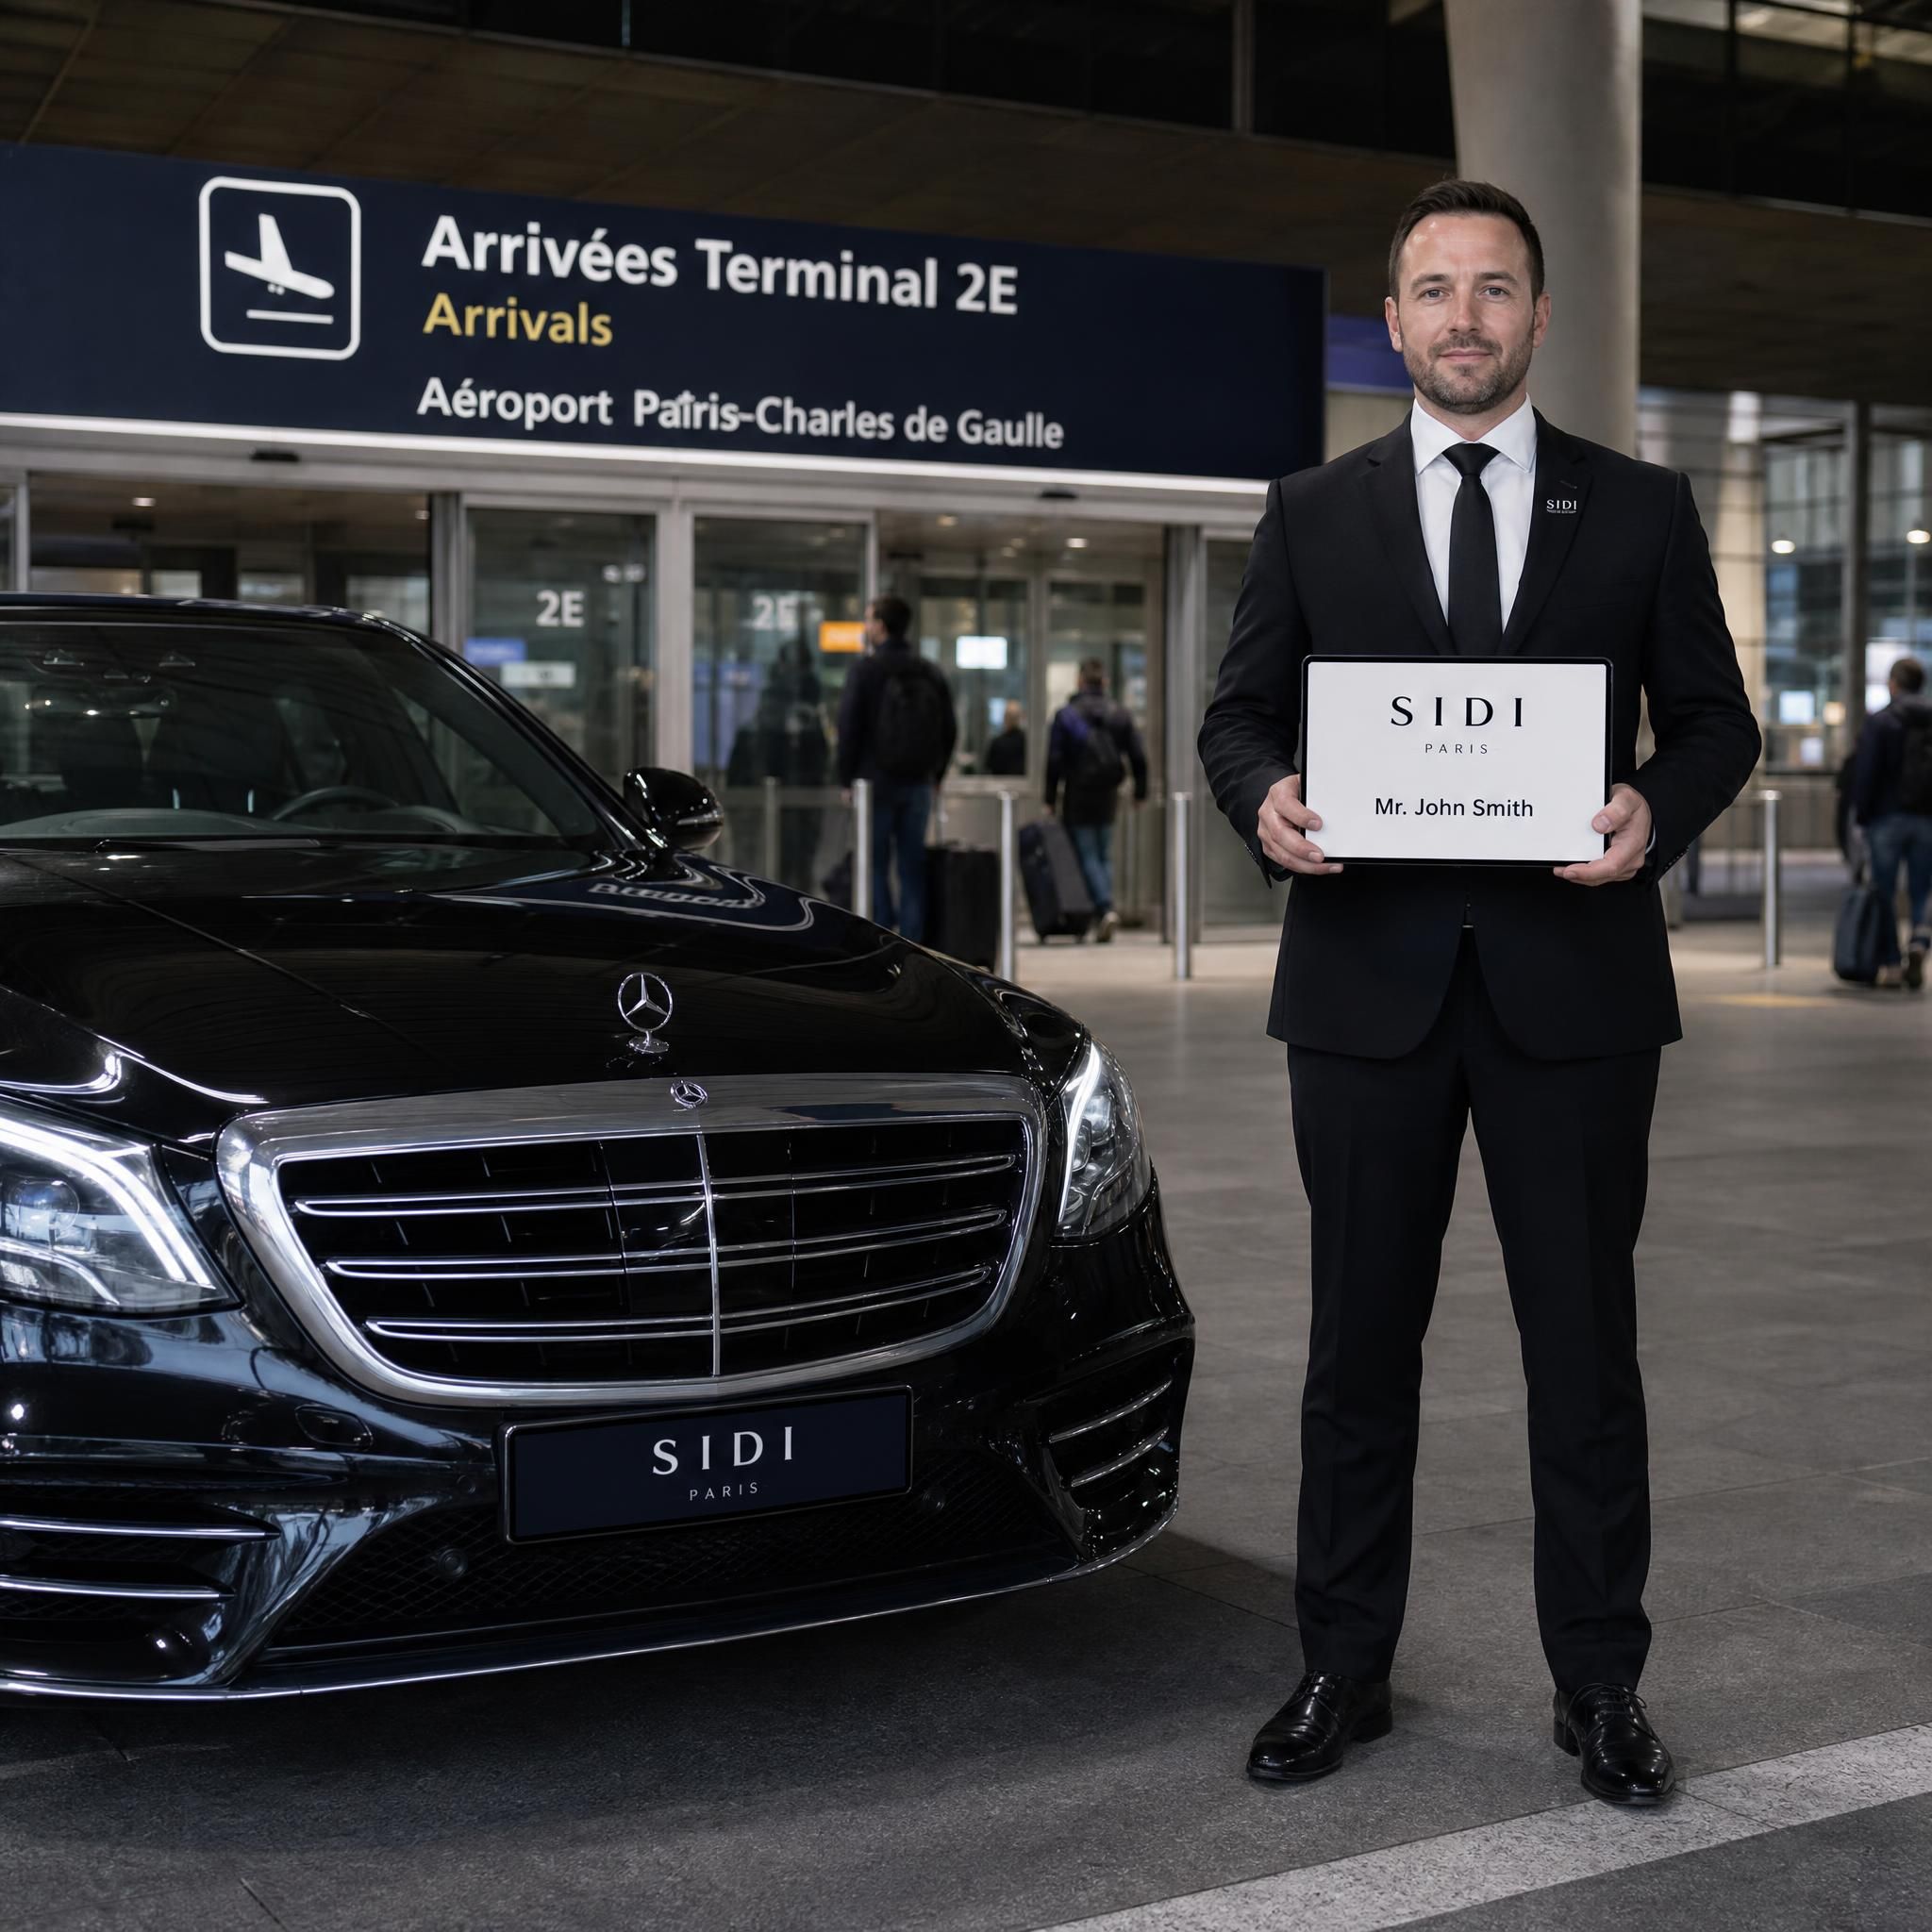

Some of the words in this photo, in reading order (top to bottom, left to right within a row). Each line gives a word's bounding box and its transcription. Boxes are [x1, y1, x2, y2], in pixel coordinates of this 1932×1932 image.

[421, 214, 678, 288] Arrivées
[694, 238, 938, 308] Terminal
[956, 262, 1018, 315] 2E
[423, 292, 612, 346] Arrivals
[416, 376, 613, 431] Aéroport
[904, 405, 949, 442] de
[957, 409, 1064, 449] Gaulle
[1546, 499, 1577, 510] SIDI
[535, 589, 585, 628] 2E
[1390, 695, 1524, 727] SIDI
[1424, 743, 1489, 755] PARIS
[1374, 797, 1407, 816] Mr.
[1414, 797, 1466, 817] John
[1473, 798, 1534, 818] Smith
[652, 1425, 793, 1475] SIDI
[689, 1481, 759, 1502] PARIS
